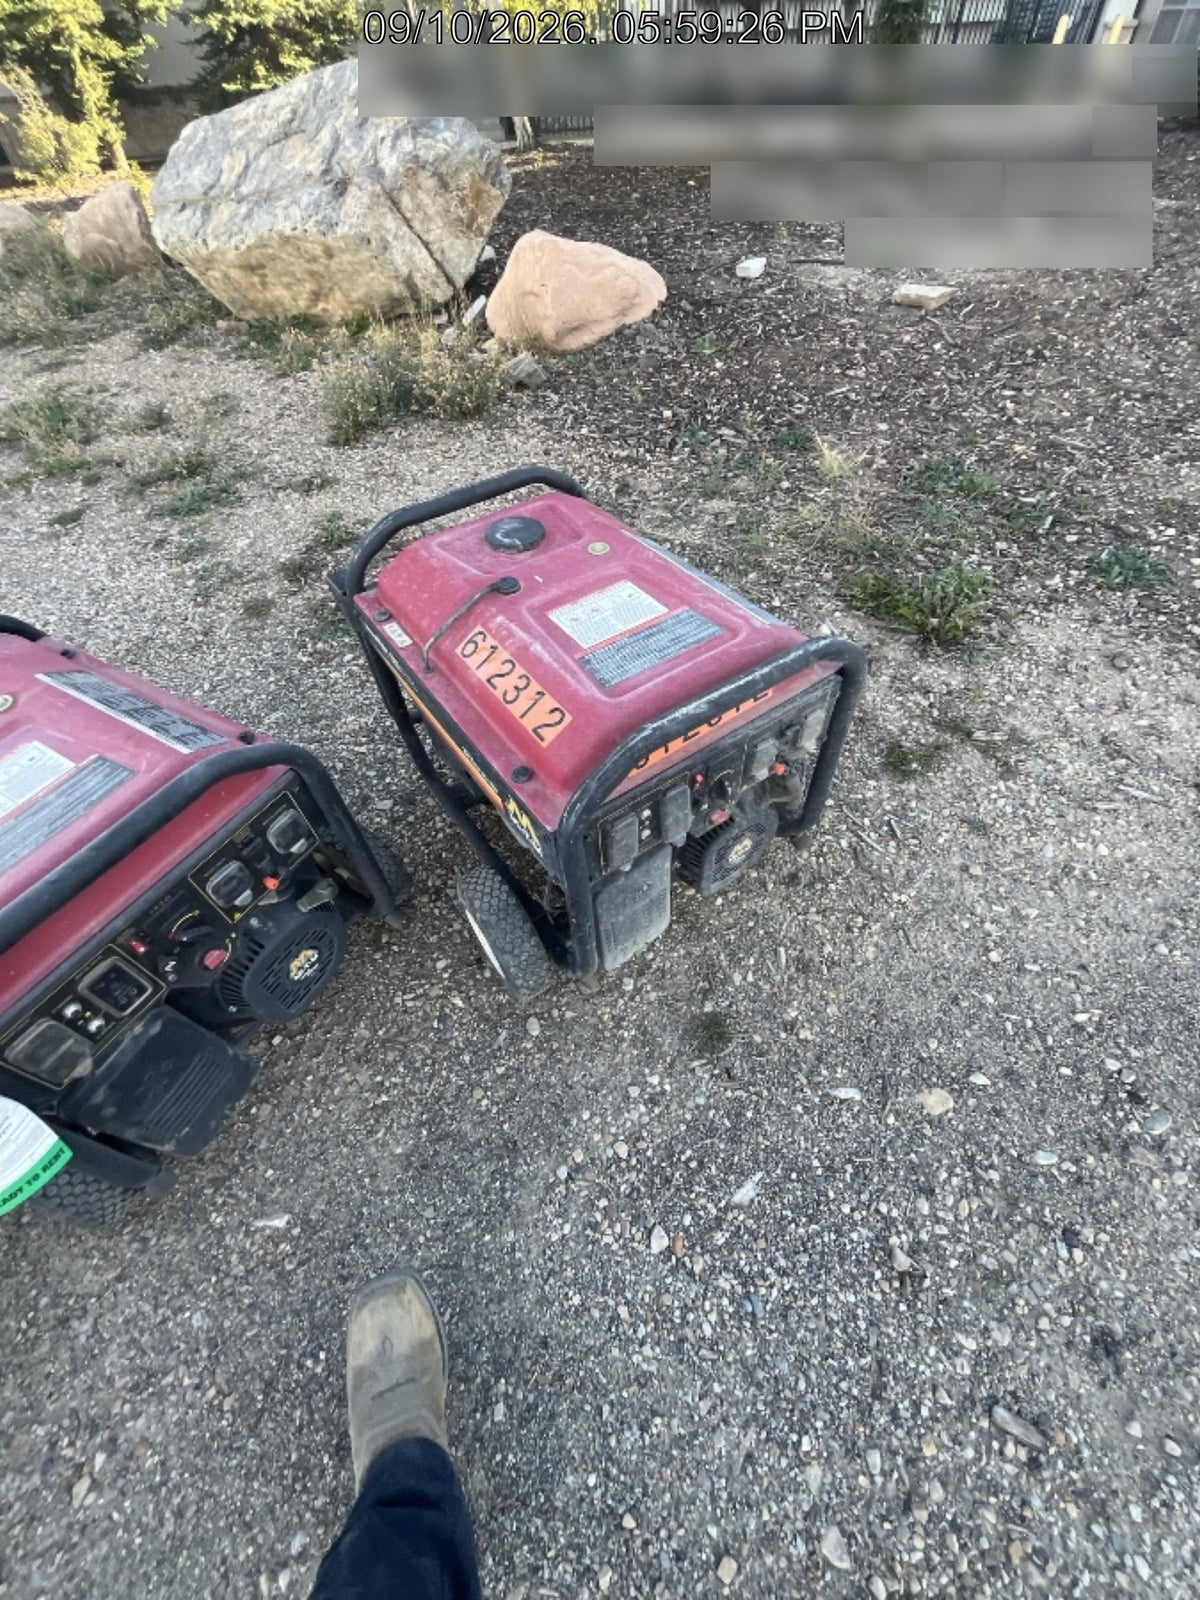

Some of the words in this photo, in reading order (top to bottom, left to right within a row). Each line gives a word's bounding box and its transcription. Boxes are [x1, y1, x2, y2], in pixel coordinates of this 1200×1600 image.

[460, 630, 566, 742] 612312
[24, 1173, 40, 1186] TO
[41, 1147, 65, 1173] RENT
